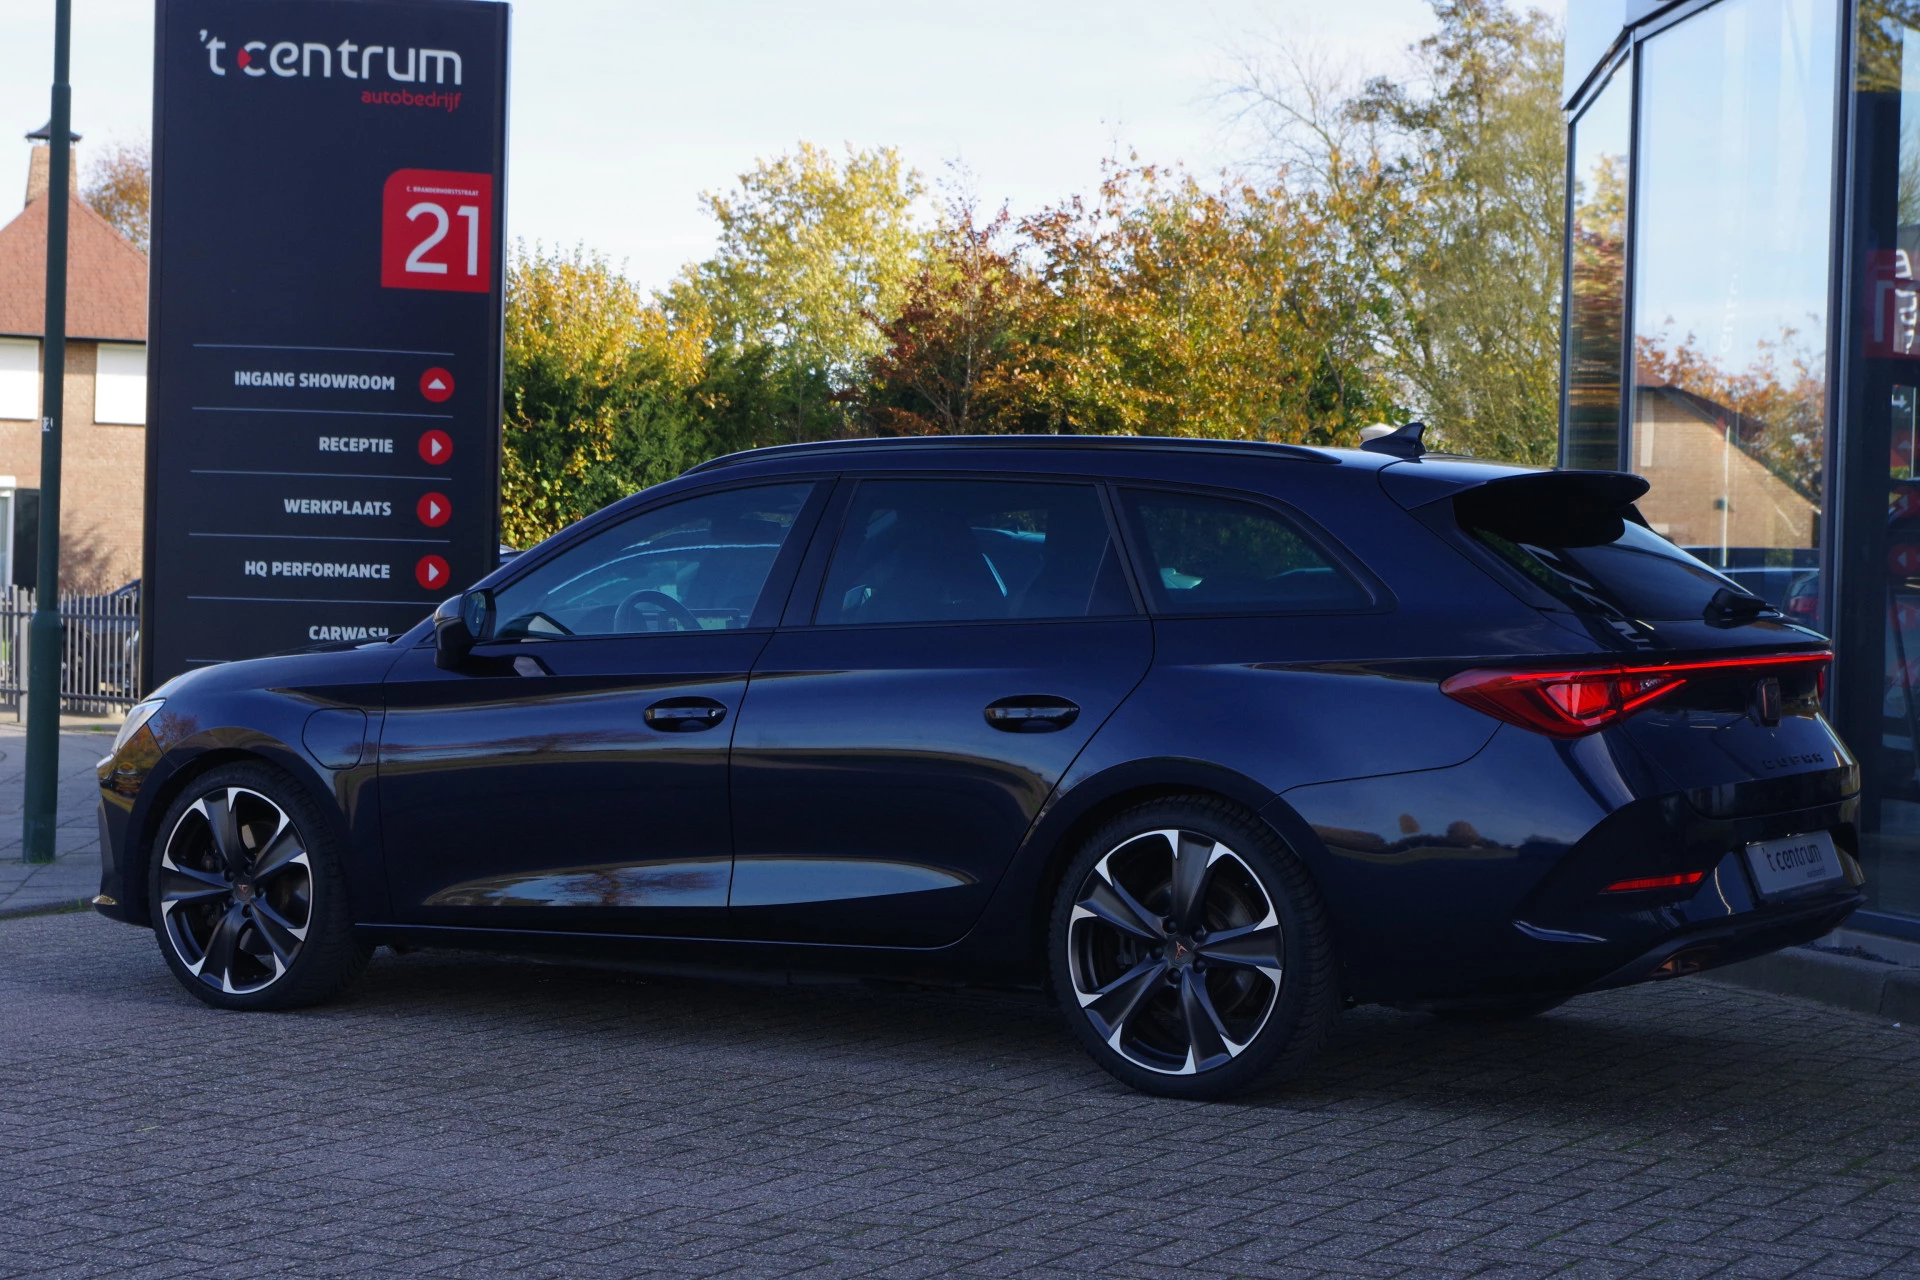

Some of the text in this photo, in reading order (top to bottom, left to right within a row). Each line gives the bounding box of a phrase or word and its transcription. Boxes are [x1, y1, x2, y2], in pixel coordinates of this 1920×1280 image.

[199, 29, 462, 85] 't centrum
[361, 89, 462, 113] autobedrijf
[405, 202, 479, 276] 21
[234, 371, 395, 391] INGANG SHOWROOM
[318, 436, 394, 454] RECEPTIE
[284, 498, 392, 516] WERKPLAATS
[245, 560, 391, 579] HQ PERFORMANCE
[308, 625, 389, 641] CARWASH
[1776, 843, 1823, 872] centrum
